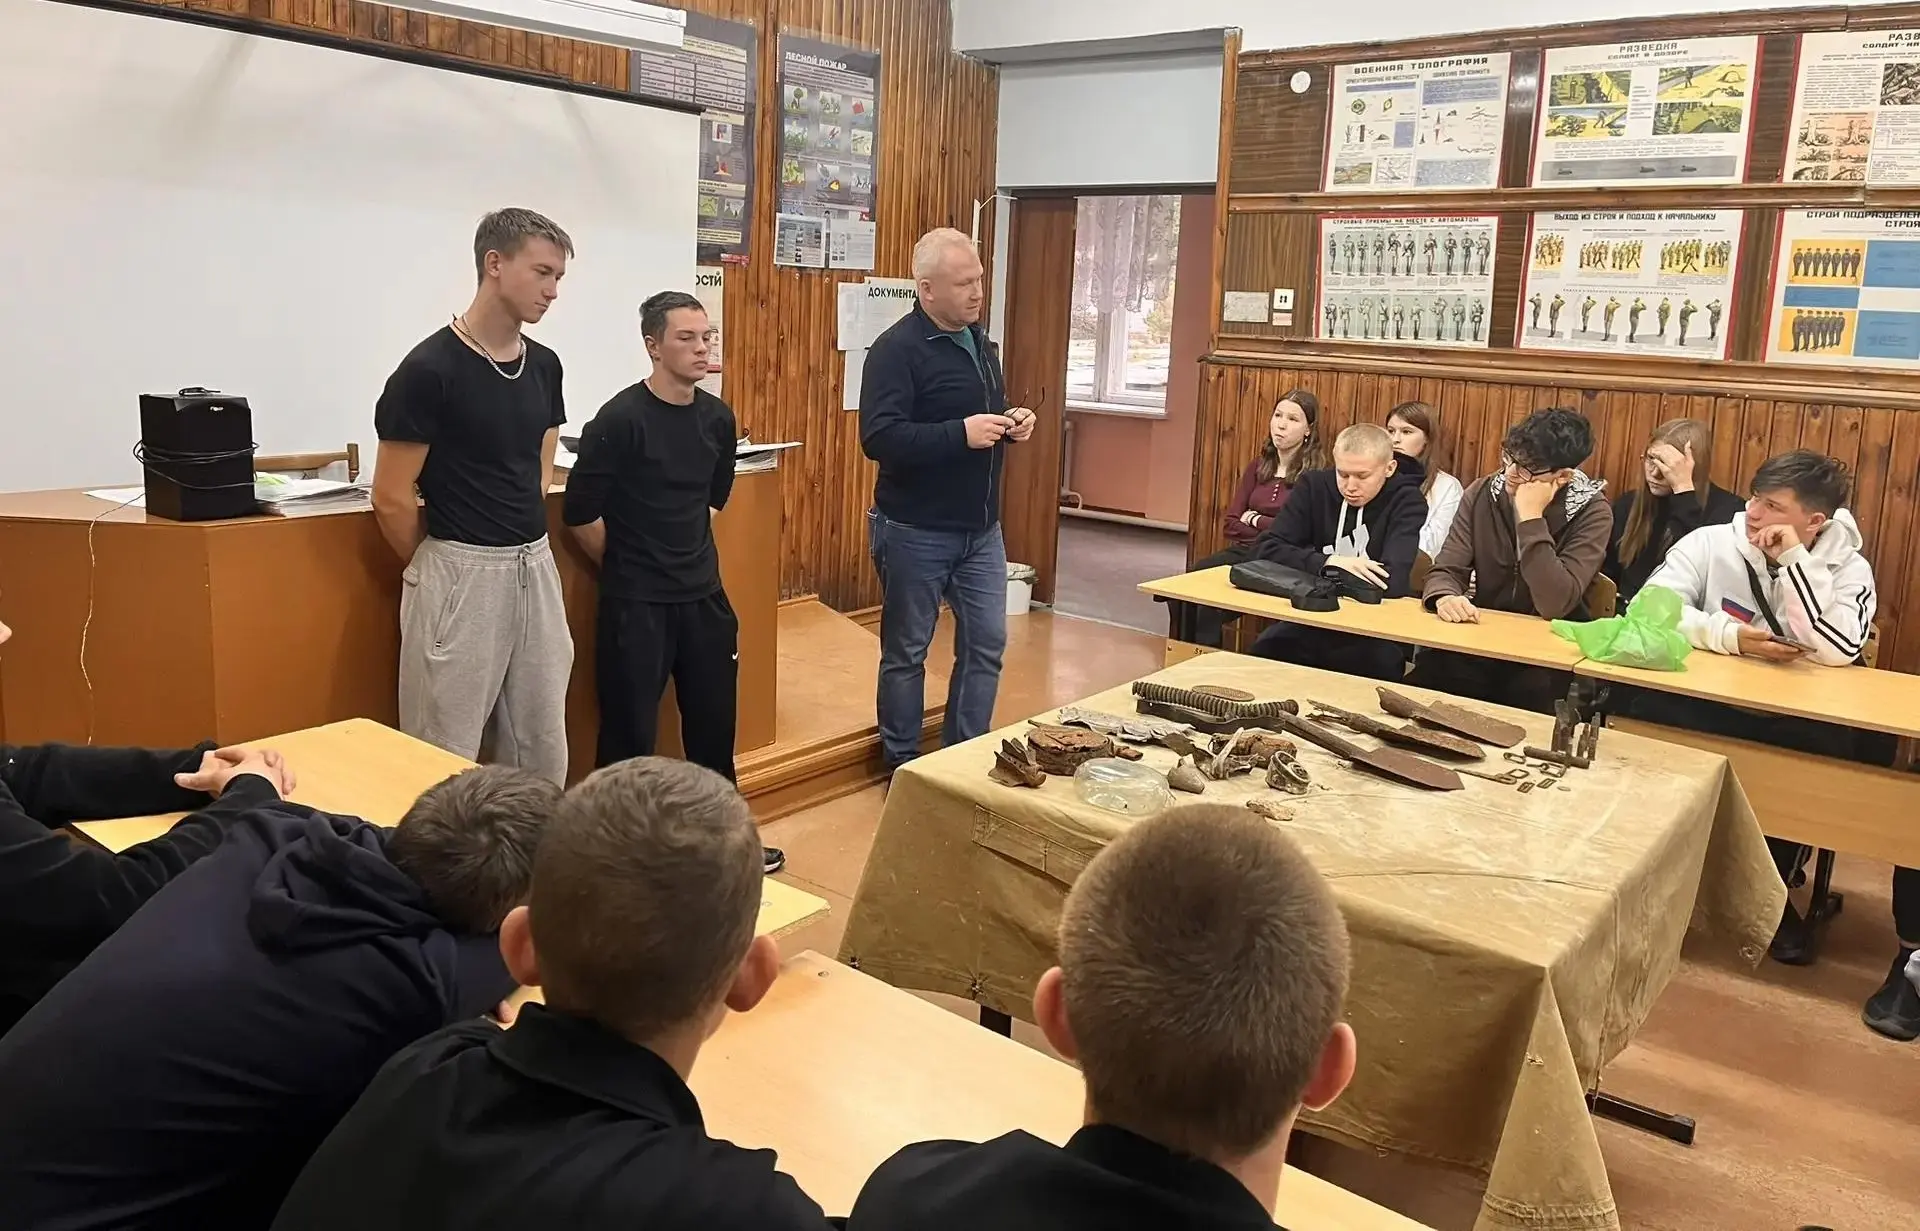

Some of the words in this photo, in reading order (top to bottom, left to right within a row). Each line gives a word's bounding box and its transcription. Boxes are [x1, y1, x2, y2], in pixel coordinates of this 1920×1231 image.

[1619, 42, 1678, 52] РАЗВЕДКА
[785, 51, 818, 65] ЛЕСНОЙ
[819, 58, 847, 71] ПОЖАР
[1354, 64, 1404, 74] ВОЕННАЯ
[1411, 57, 1488, 69] ТОПОГРАФИЯ
